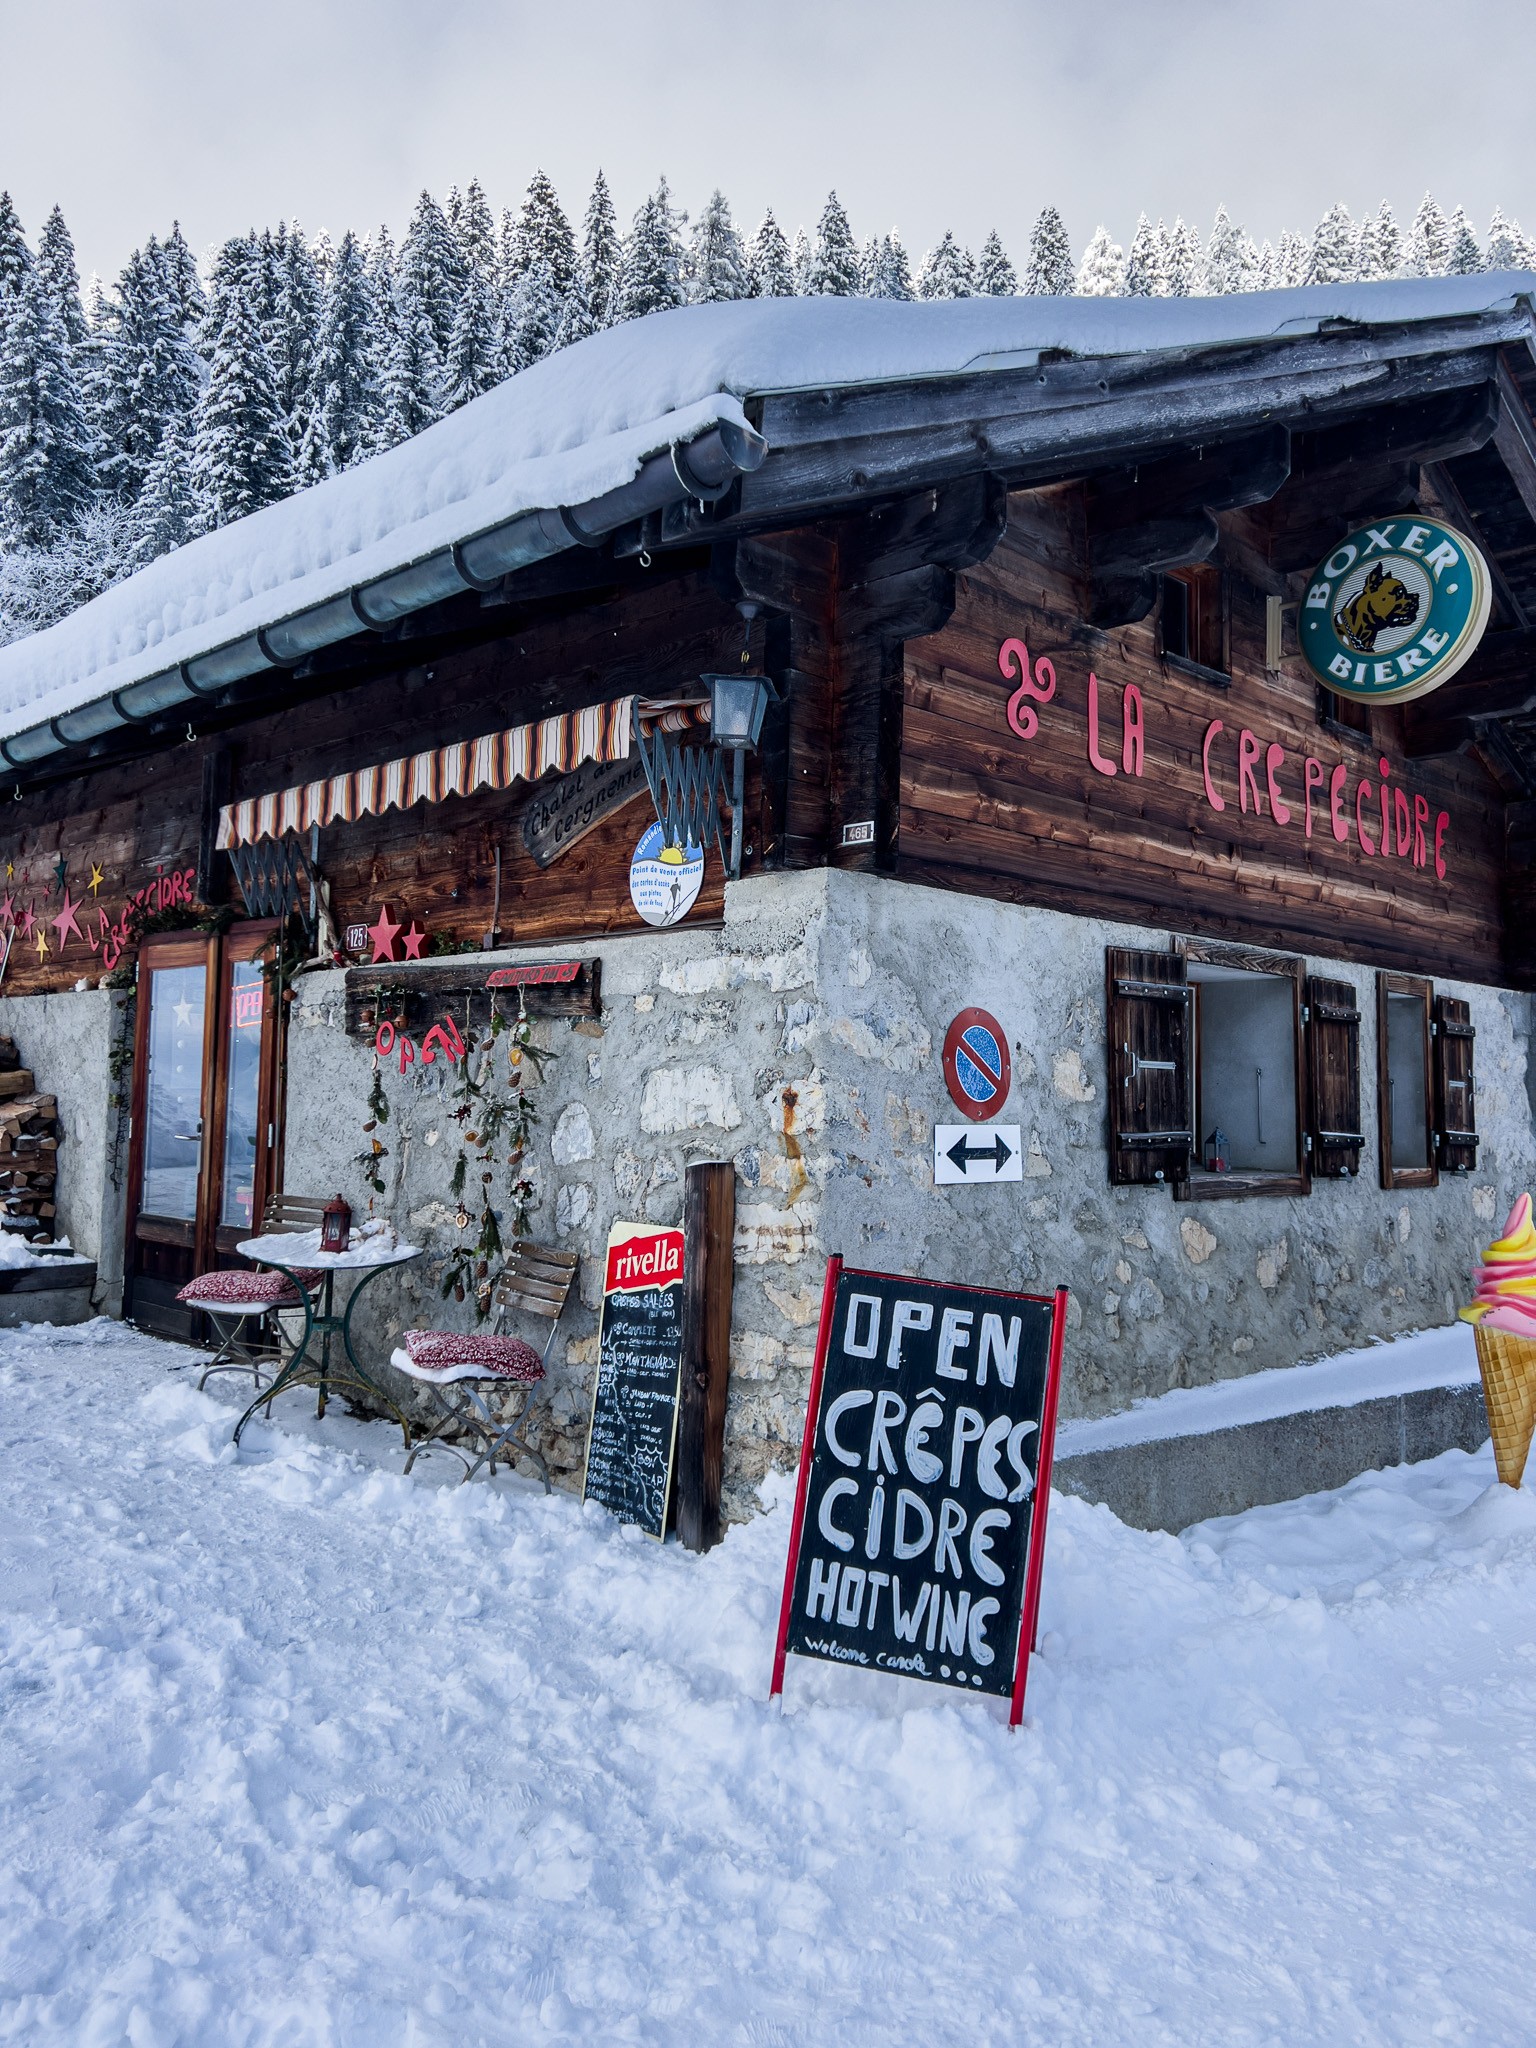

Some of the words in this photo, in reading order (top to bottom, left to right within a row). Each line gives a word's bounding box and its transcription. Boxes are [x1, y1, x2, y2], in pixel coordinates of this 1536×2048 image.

[1305, 524, 1460, 611] BOXER
[1327, 627, 1450, 685] BIERE
[1087, 671, 1145, 778] LA
[531, 774, 584, 836] Chalet
[849, 826, 868, 840] 465
[632, 864, 649, 876] Point
[660, 867, 677, 876] vente
[678, 863, 702, 876] officiel
[86, 906, 110, 952] LA
[349, 927, 364, 949] 125
[236, 990, 263, 1019] OPE
[375, 1015, 466, 1075] OPEN
[615, 1238, 679, 1280] rivella
[843, 1292, 1022, 1388] OPEN
[824, 1387, 1039, 1503] CRÊPES
[804, 1636, 870, 1665] Welcome
